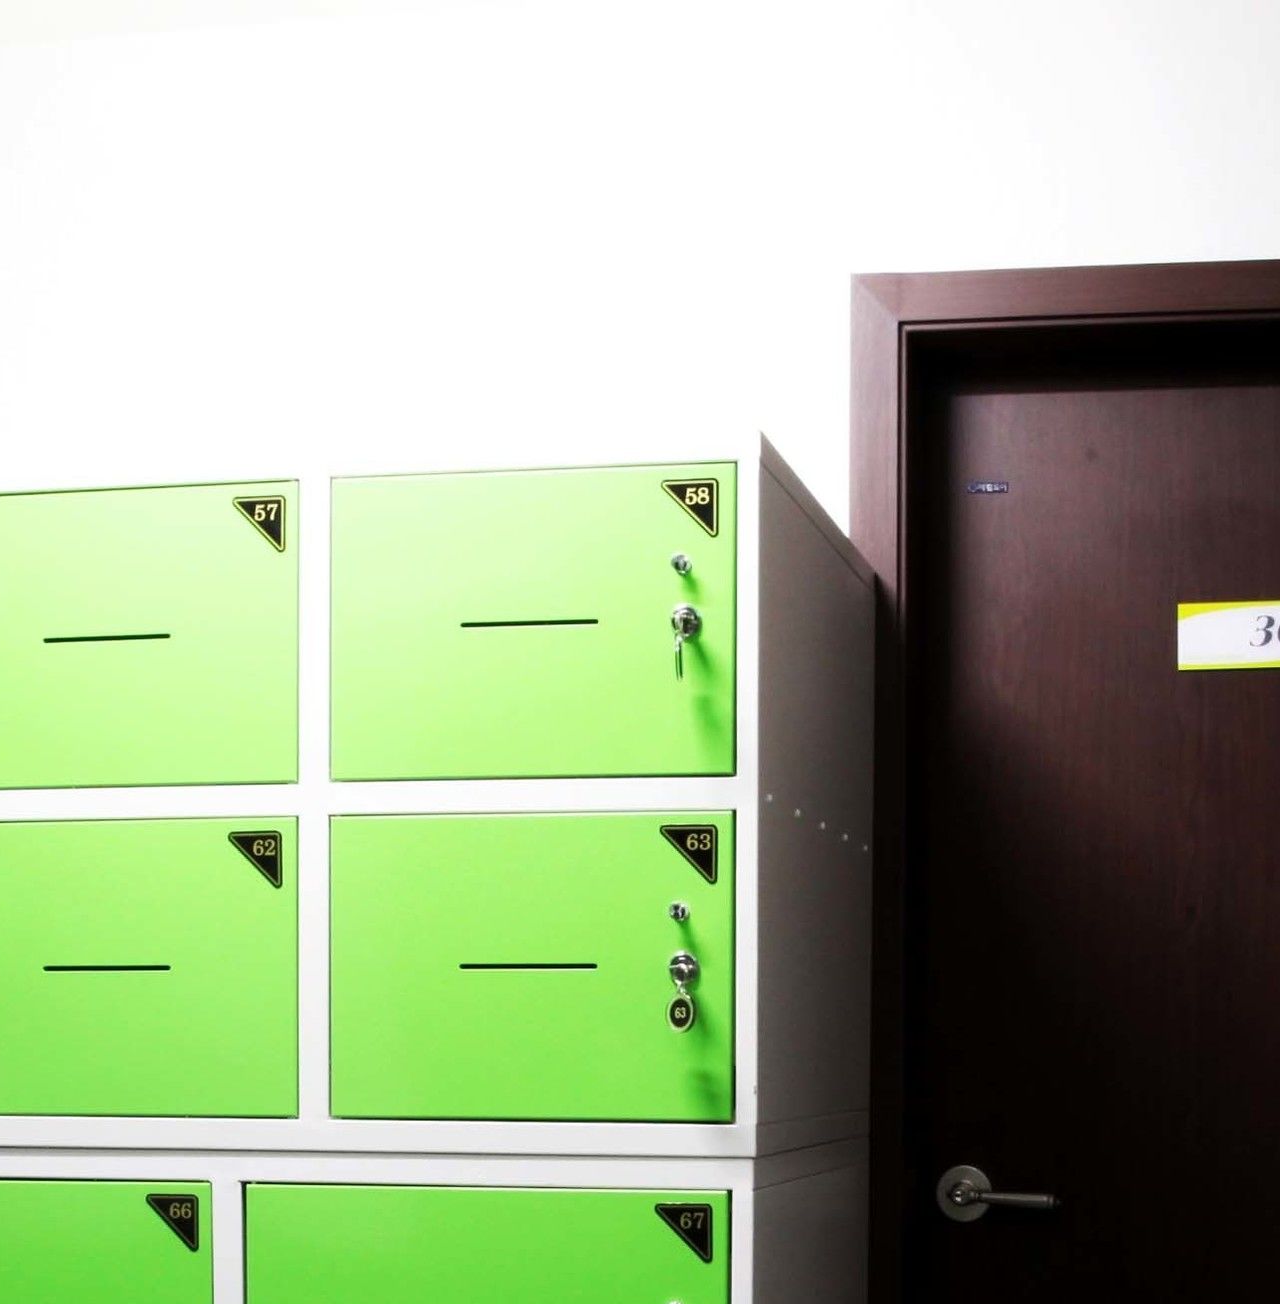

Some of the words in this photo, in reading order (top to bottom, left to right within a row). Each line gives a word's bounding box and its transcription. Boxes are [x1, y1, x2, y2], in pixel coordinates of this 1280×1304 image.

[685, 486, 709, 504] 58
[254, 503, 278, 521] 57
[252, 839, 276, 857] 62
[686, 833, 711, 851] 63
[675, 1006, 687, 1019] 63
[169, 1202, 192, 1219] 66
[679, 1212, 704, 1230] 67
